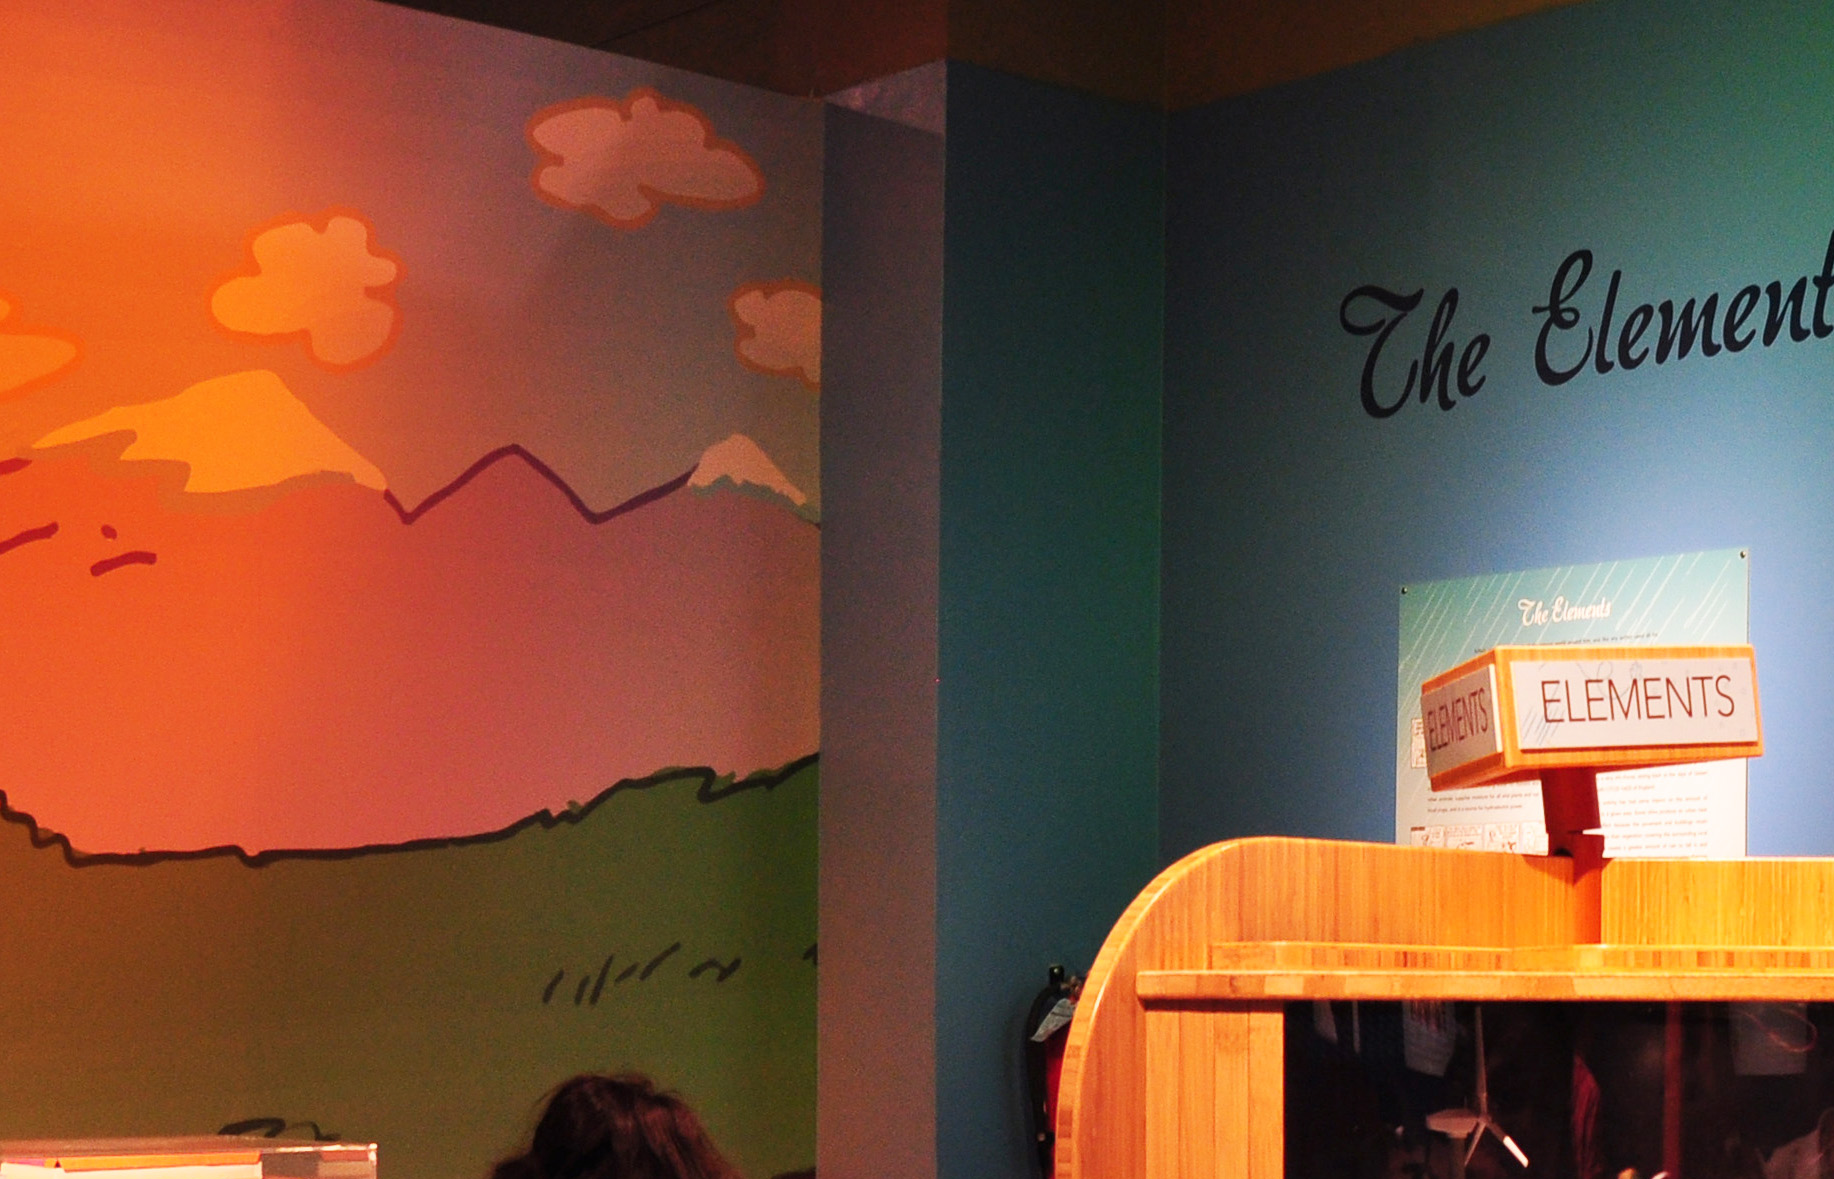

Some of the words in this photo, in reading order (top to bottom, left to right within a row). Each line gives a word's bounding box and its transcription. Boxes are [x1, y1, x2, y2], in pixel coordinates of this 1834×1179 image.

[1339, 283, 1492, 419] The
[1517, 598, 1549, 627] The
[1552, 595, 1612, 623] Elements
[1426, 687, 1489, 752] ELEMENTS
[1541, 674, 1736, 724] ELEMENTS
